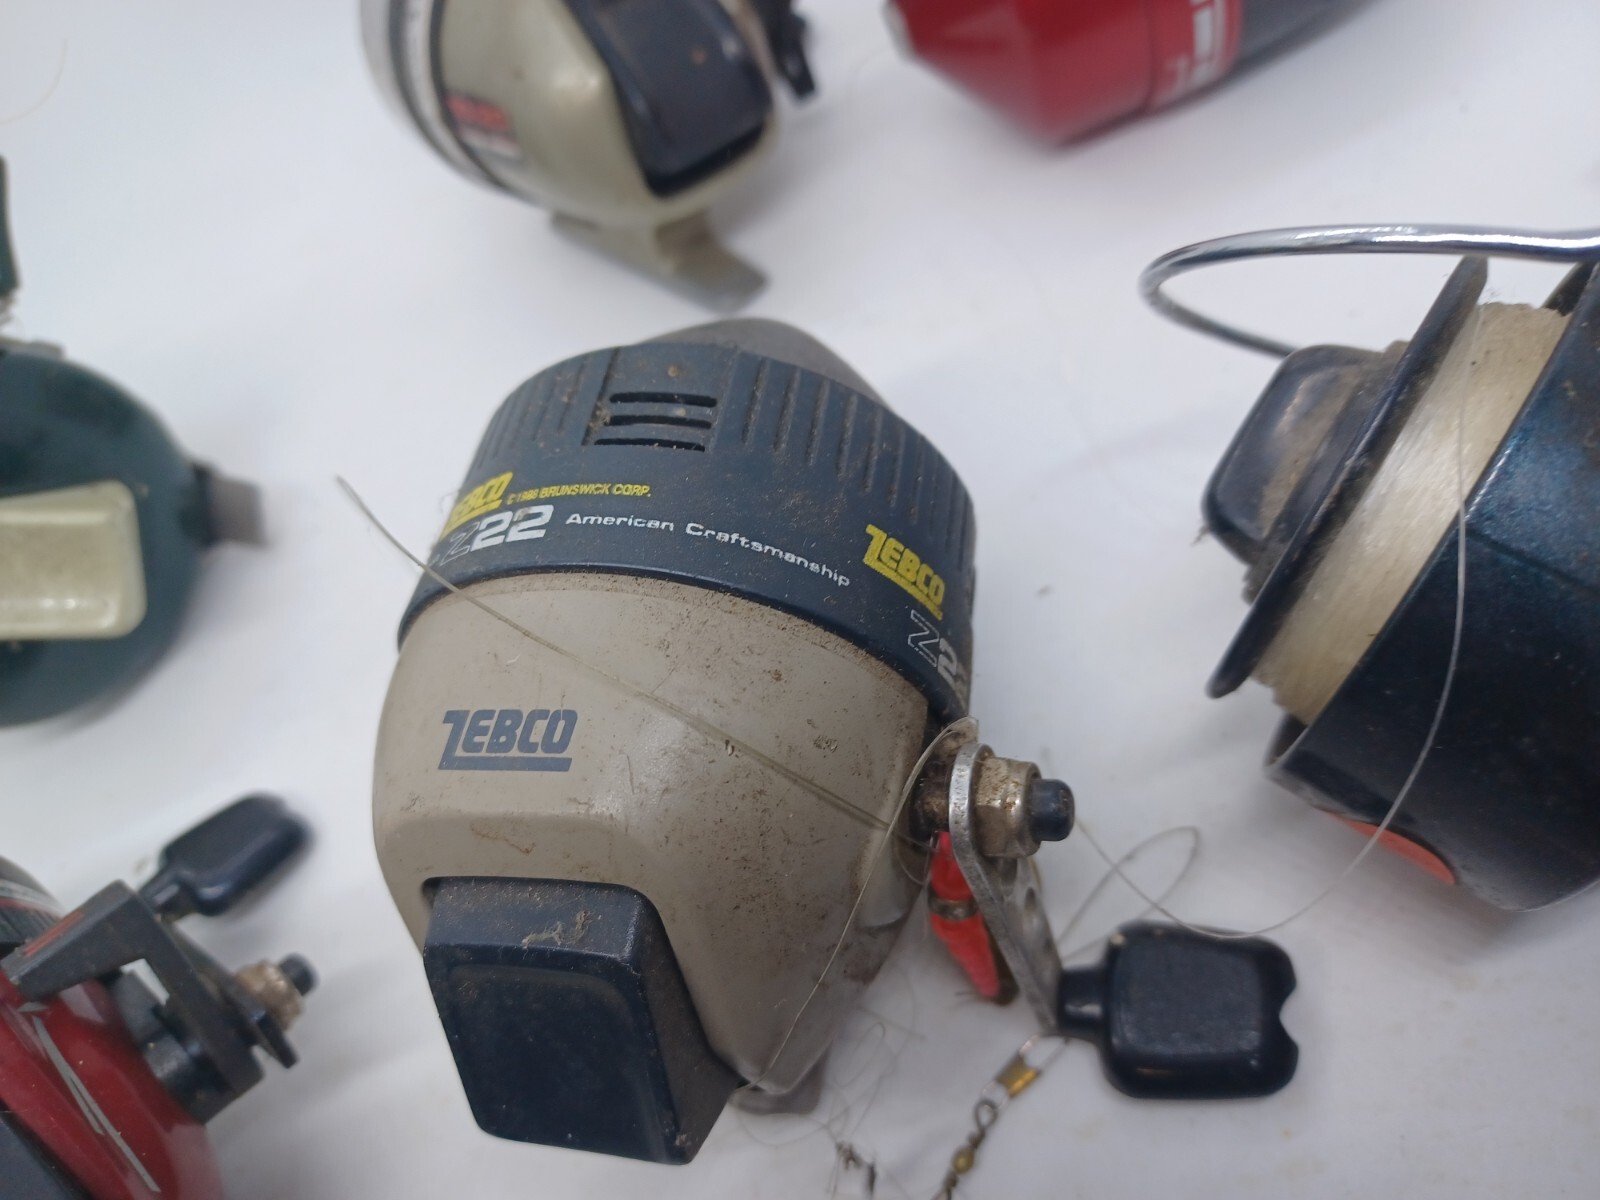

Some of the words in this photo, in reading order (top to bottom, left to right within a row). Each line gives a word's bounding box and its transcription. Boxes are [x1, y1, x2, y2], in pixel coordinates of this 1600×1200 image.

[539, 483, 611, 498] BRUNSWICK
[612, 483, 651, 498] CORP.
[566, 513, 674, 532] American
[685, 522, 851, 588] Craftsmanship
[863, 523, 945, 621] ZEBCO
[438, 709, 578, 772] ZEBCO
